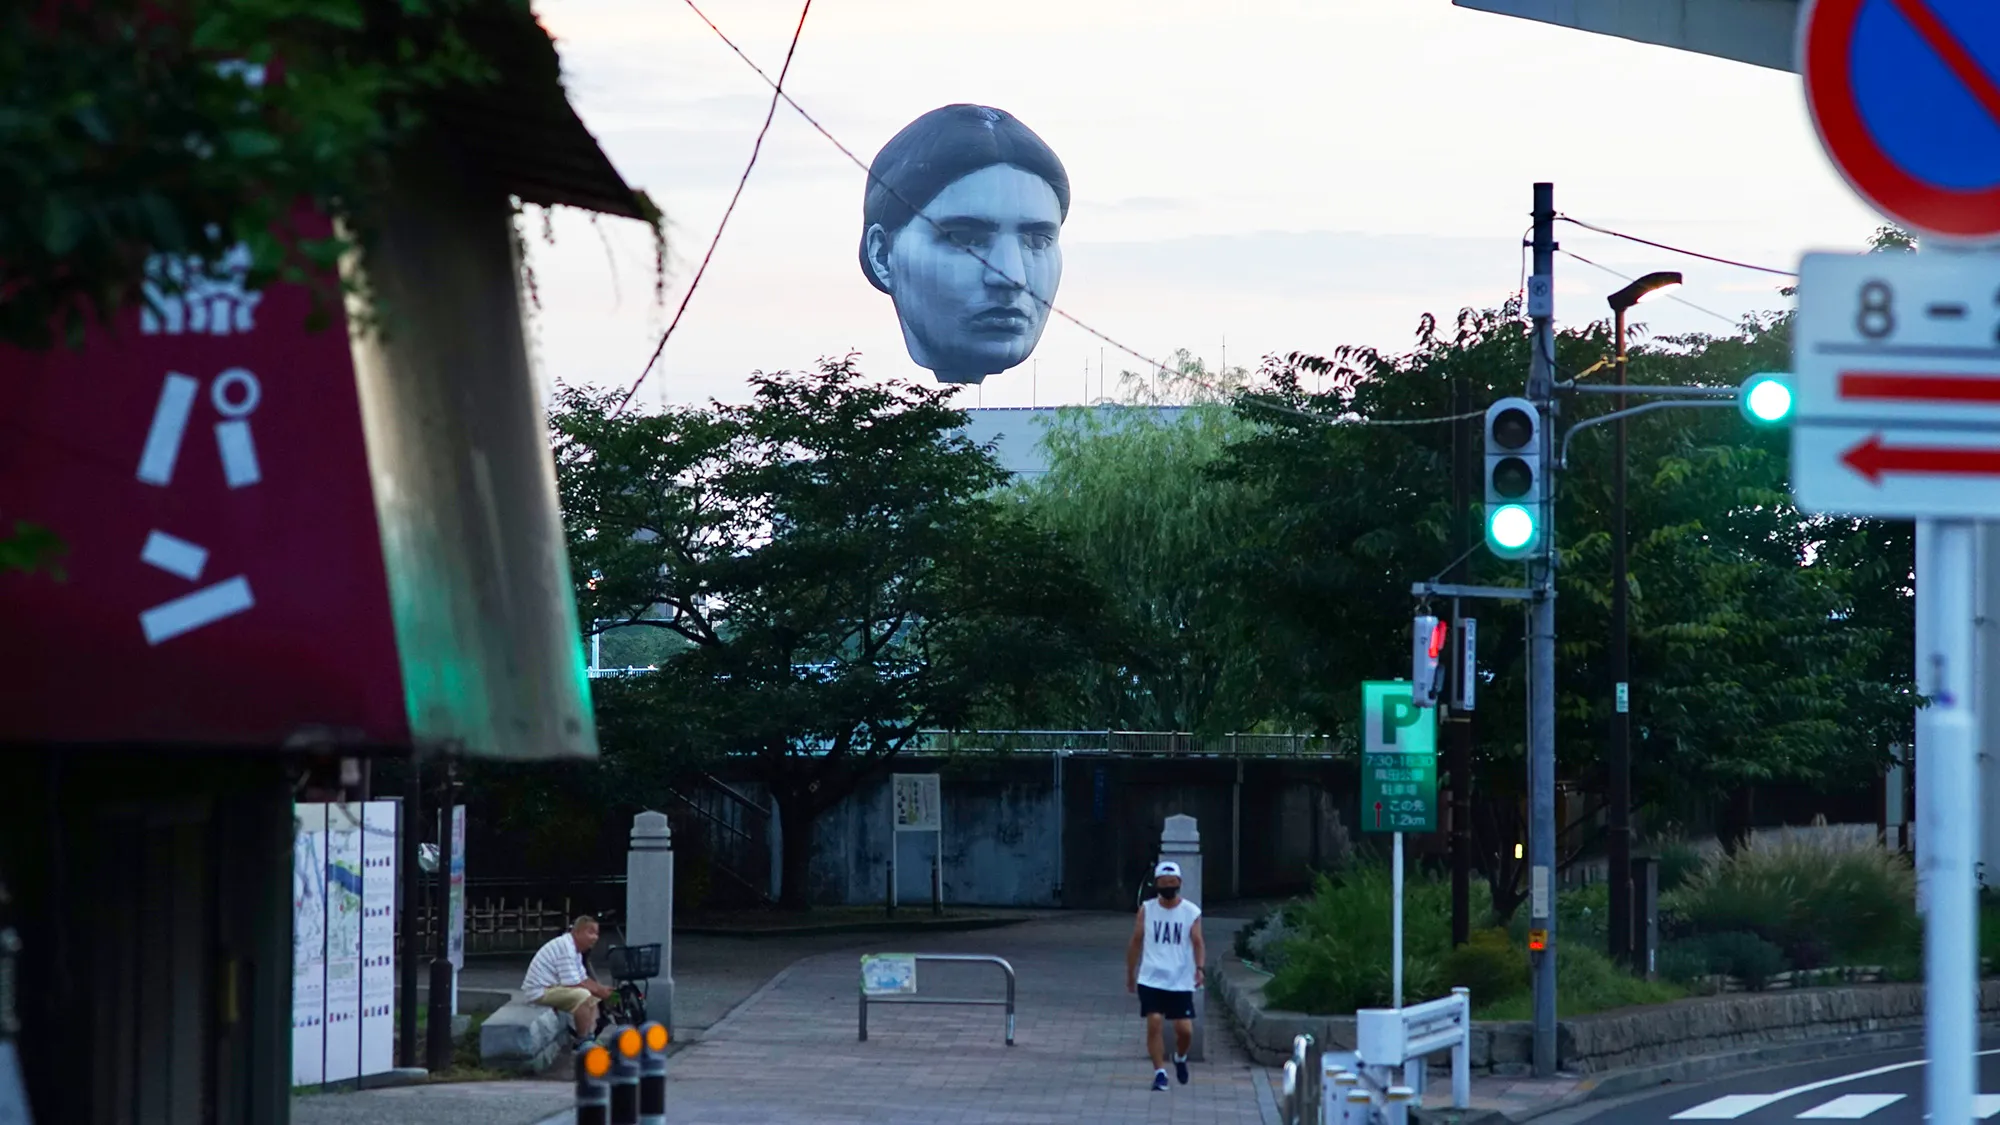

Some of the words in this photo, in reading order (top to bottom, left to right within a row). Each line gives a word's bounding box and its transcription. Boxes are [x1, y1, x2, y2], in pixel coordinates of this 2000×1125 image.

[1856, 278, 2000, 342] 8-
[1383, 694, 1422, 744] P
[1389, 799, 1426, 812] この先
[1389, 813, 1426, 826] 1.2km
[1153, 920, 1183, 945] VAN
